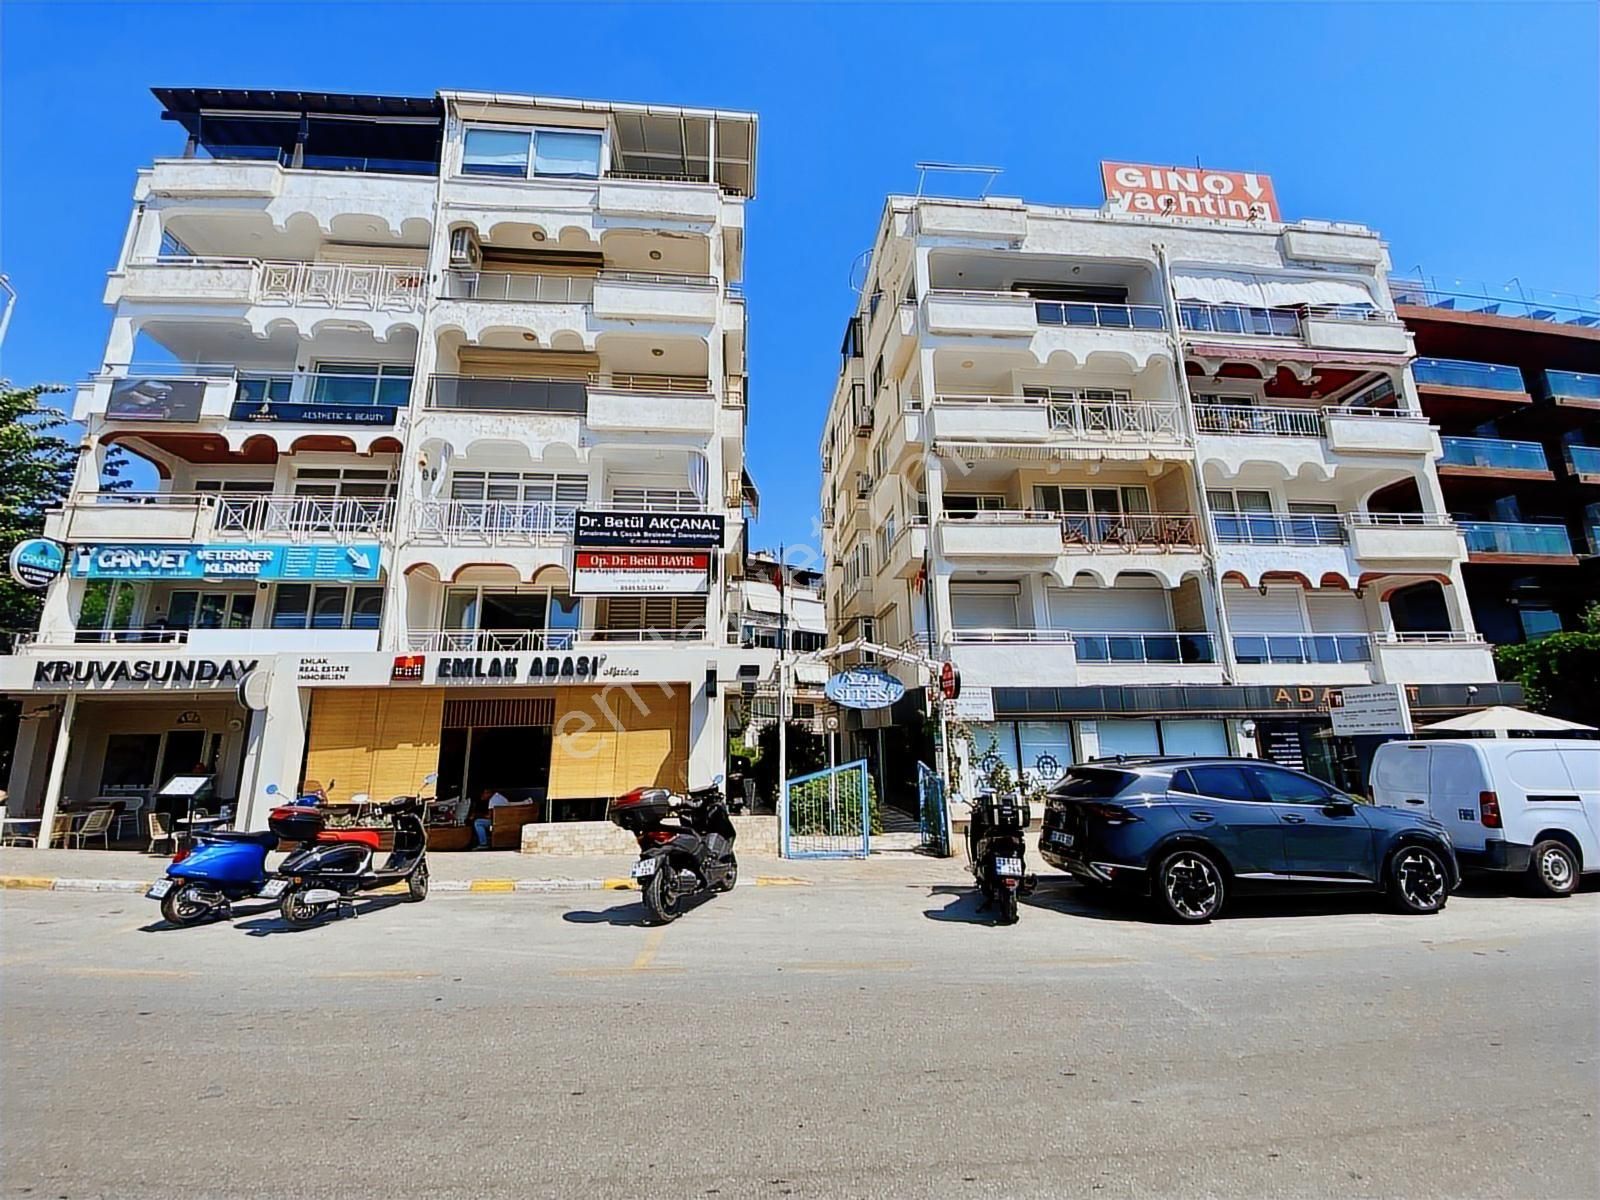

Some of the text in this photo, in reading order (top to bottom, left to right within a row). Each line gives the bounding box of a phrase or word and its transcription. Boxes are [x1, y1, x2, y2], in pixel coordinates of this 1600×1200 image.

[1115, 167, 1234, 196] GINO
[302, 411, 344, 421] AESTHETIC
[355, 412, 384, 422] BEAUTY
[579, 515, 721, 533] Dr. Betül AKÇANAL
[98, 549, 191, 569] CAN-VET
[590, 555, 695, 568] Op. Dr. Betül BAYIR
[34, 660, 259, 682] KRUVASUNDAY
[437, 656, 599, 678] EMLAK ADASI
